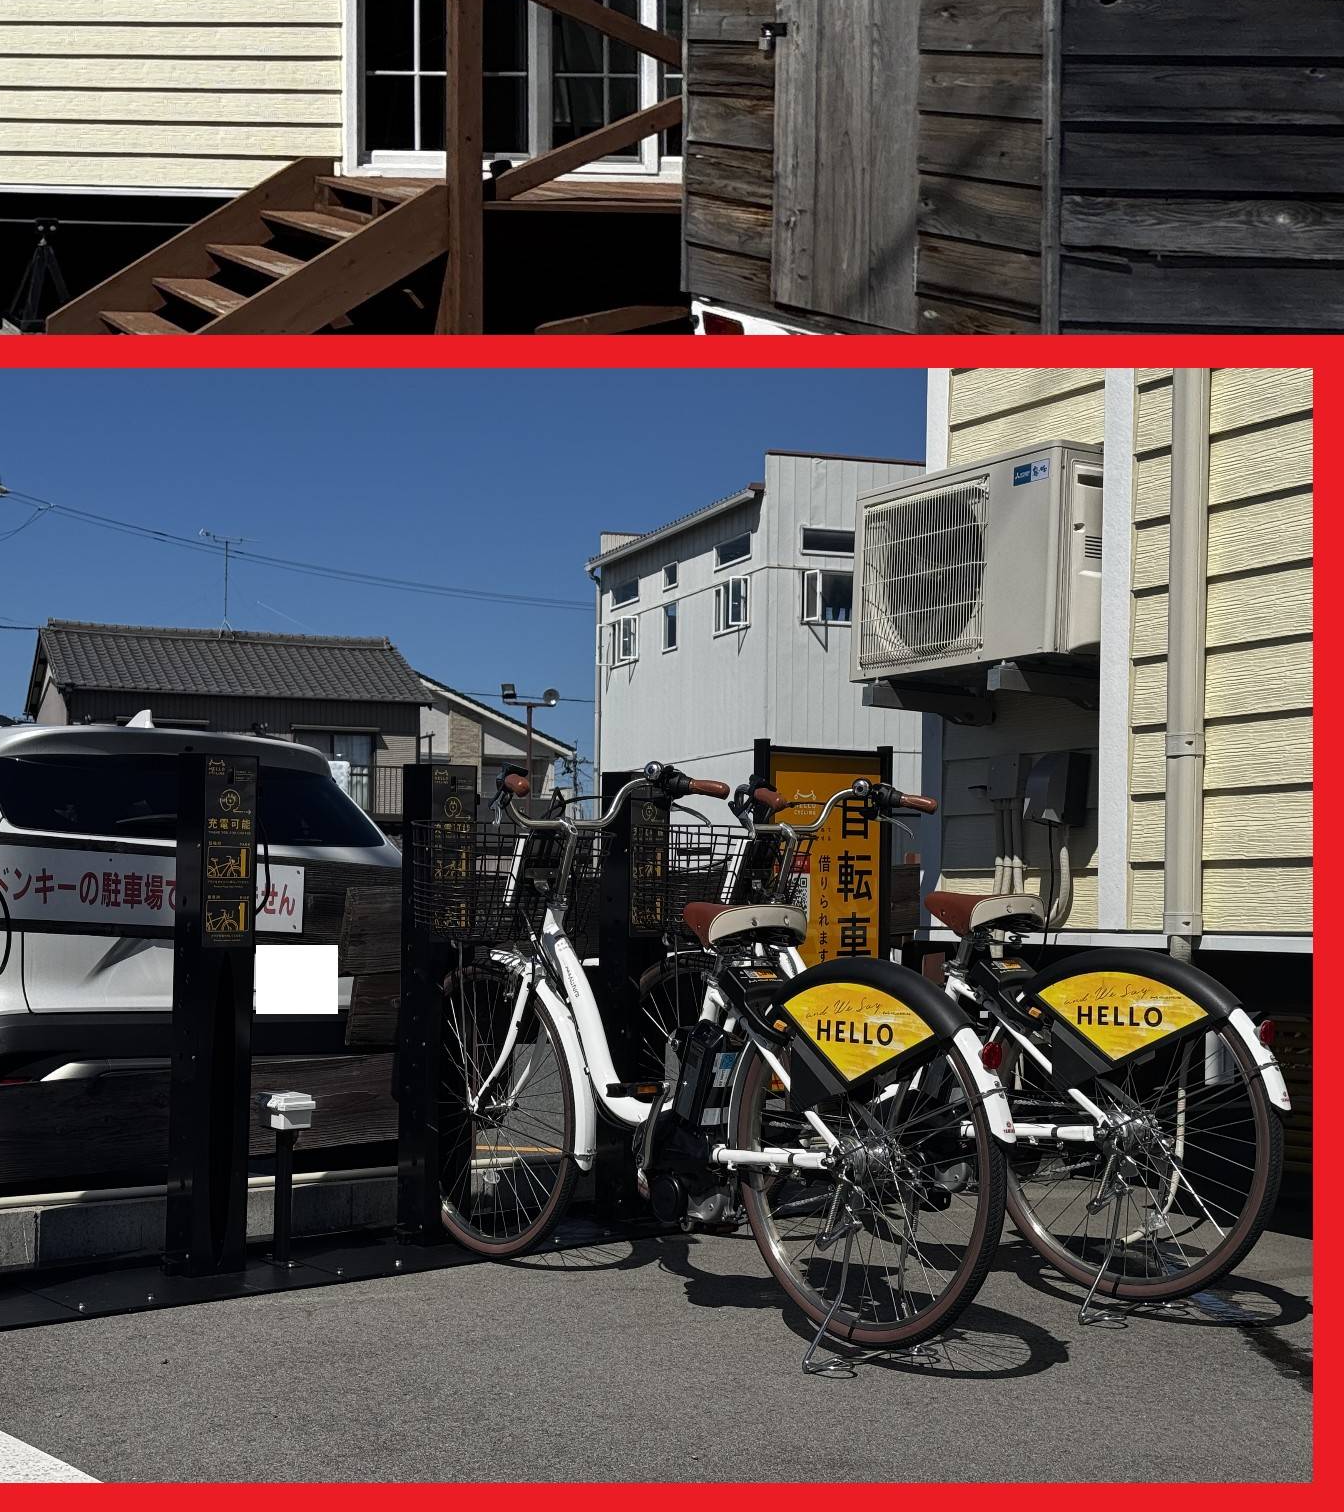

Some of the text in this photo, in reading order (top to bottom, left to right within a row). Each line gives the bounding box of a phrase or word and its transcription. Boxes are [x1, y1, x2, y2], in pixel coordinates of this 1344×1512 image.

[208, 818, 251, 830] 充電可能
[837, 799, 873, 957] 自転車
[818, 855, 831, 963] 借りられます
[1064, 983, 1152, 1005] and We Say
[805, 997, 882, 1018] and We Say
[1077, 1005, 1163, 1027] HELLO
[816, 1019, 893, 1046] HELLO
